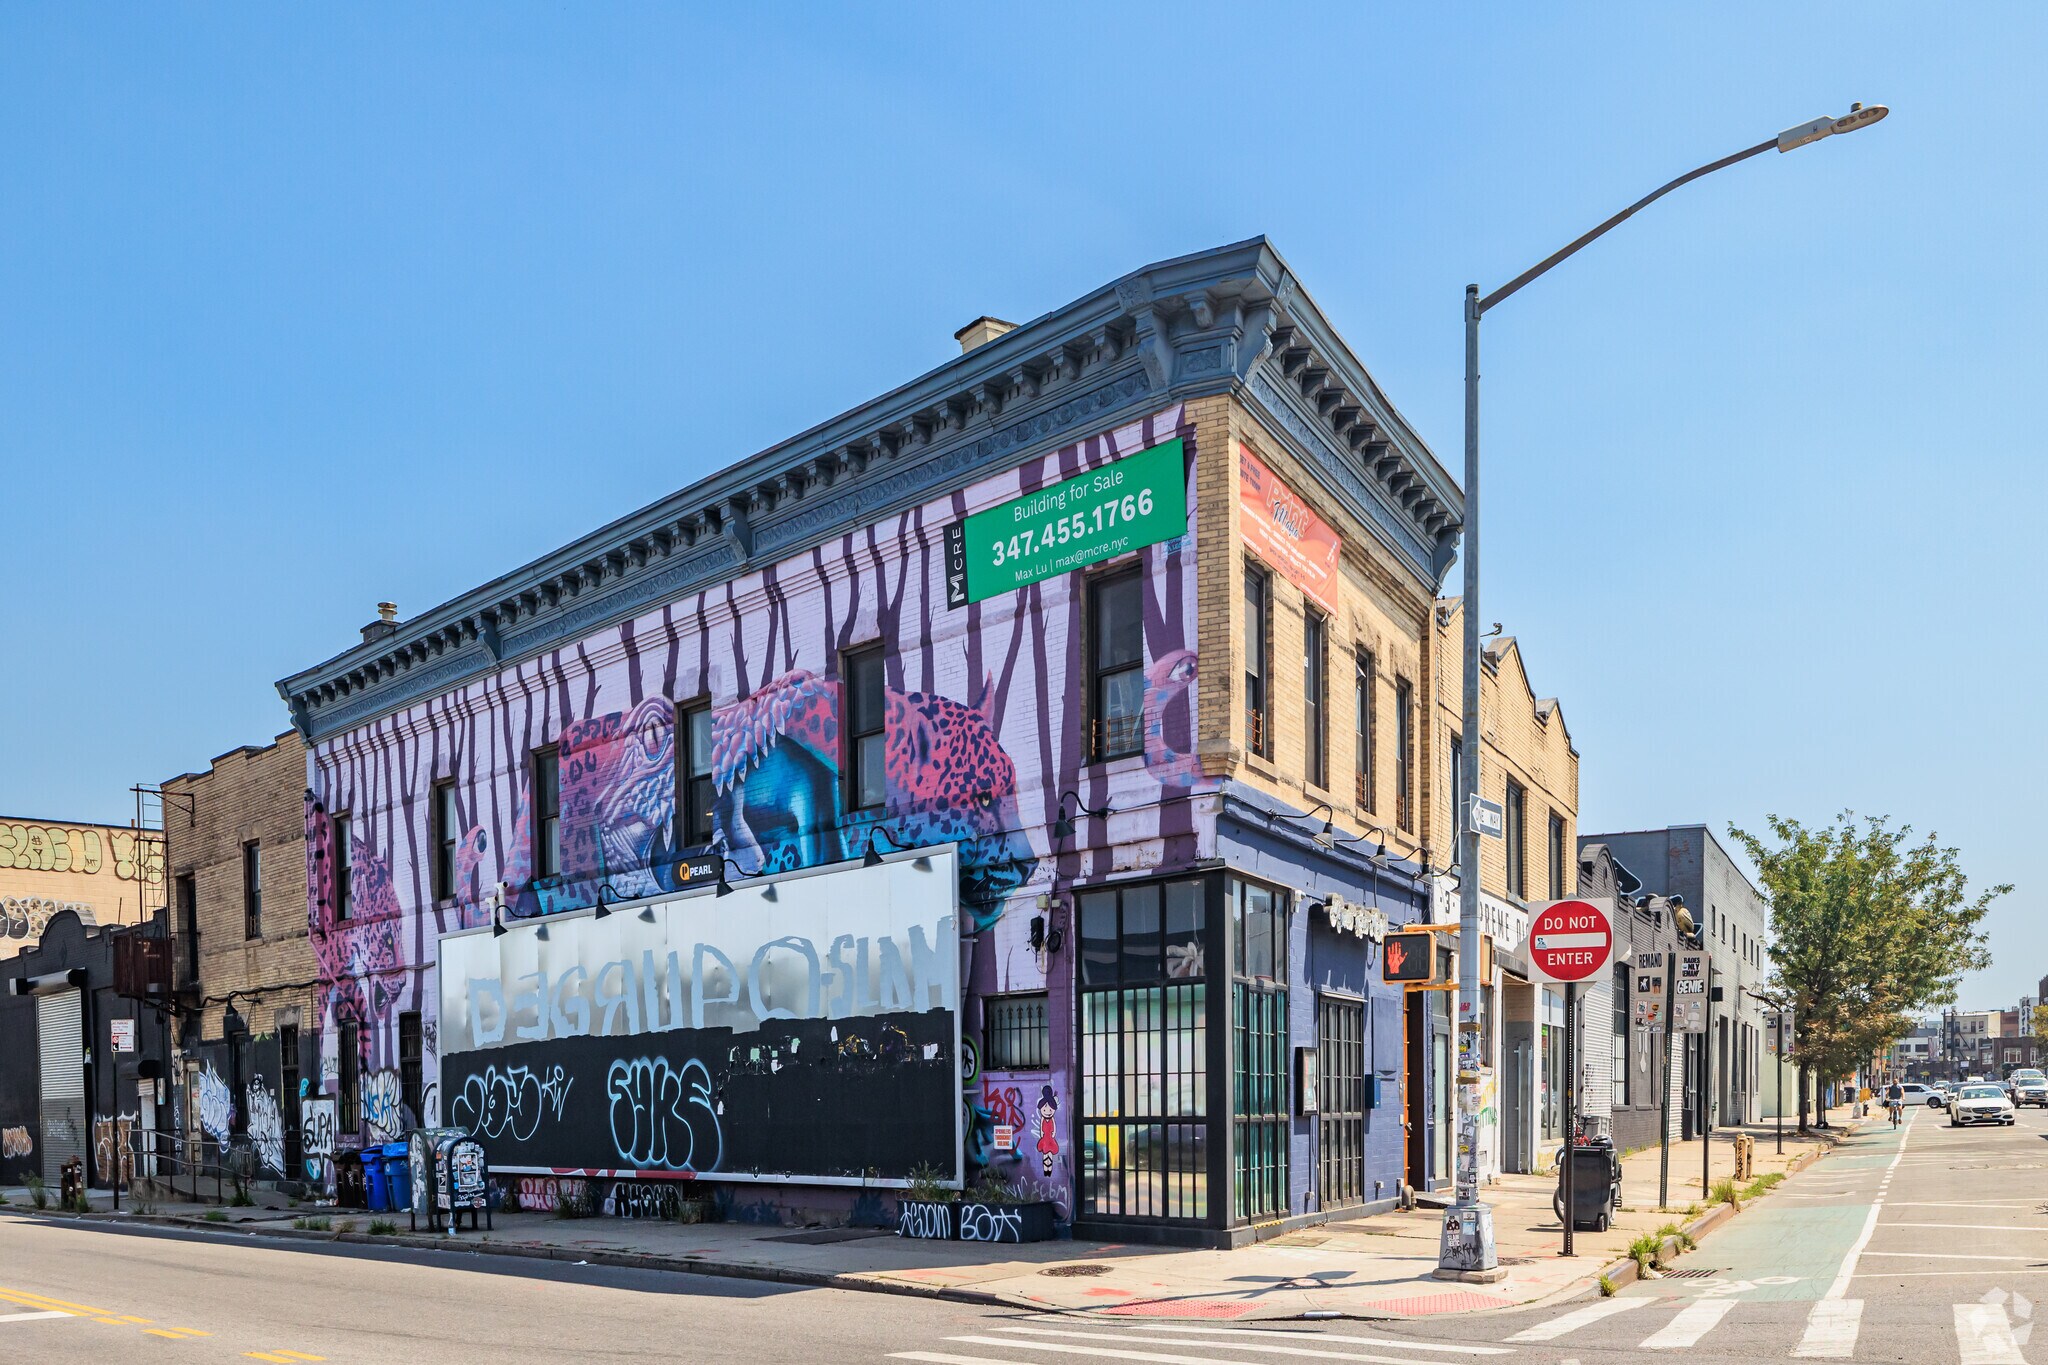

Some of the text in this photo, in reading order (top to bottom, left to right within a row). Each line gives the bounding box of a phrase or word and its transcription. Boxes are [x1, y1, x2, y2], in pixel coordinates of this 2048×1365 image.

[1013, 469, 1124, 522] Building for Sale
[991, 487, 1154, 567] 347.455.1766
[950, 526, 965, 603] MCRE
[1015, 568, 1034, 582] Max
[1036, 564, 1048, 575] Lu
[1055, 535, 1129, 570] max@mcre.nyc
[1474, 806, 1500, 829] ONE WAY
[690, 864, 713, 877] PEARL
[1544, 916, 1597, 930] DO NOT
[1547, 952, 1593, 966] ENTER
[1677, 979, 1704, 994] GENIE
